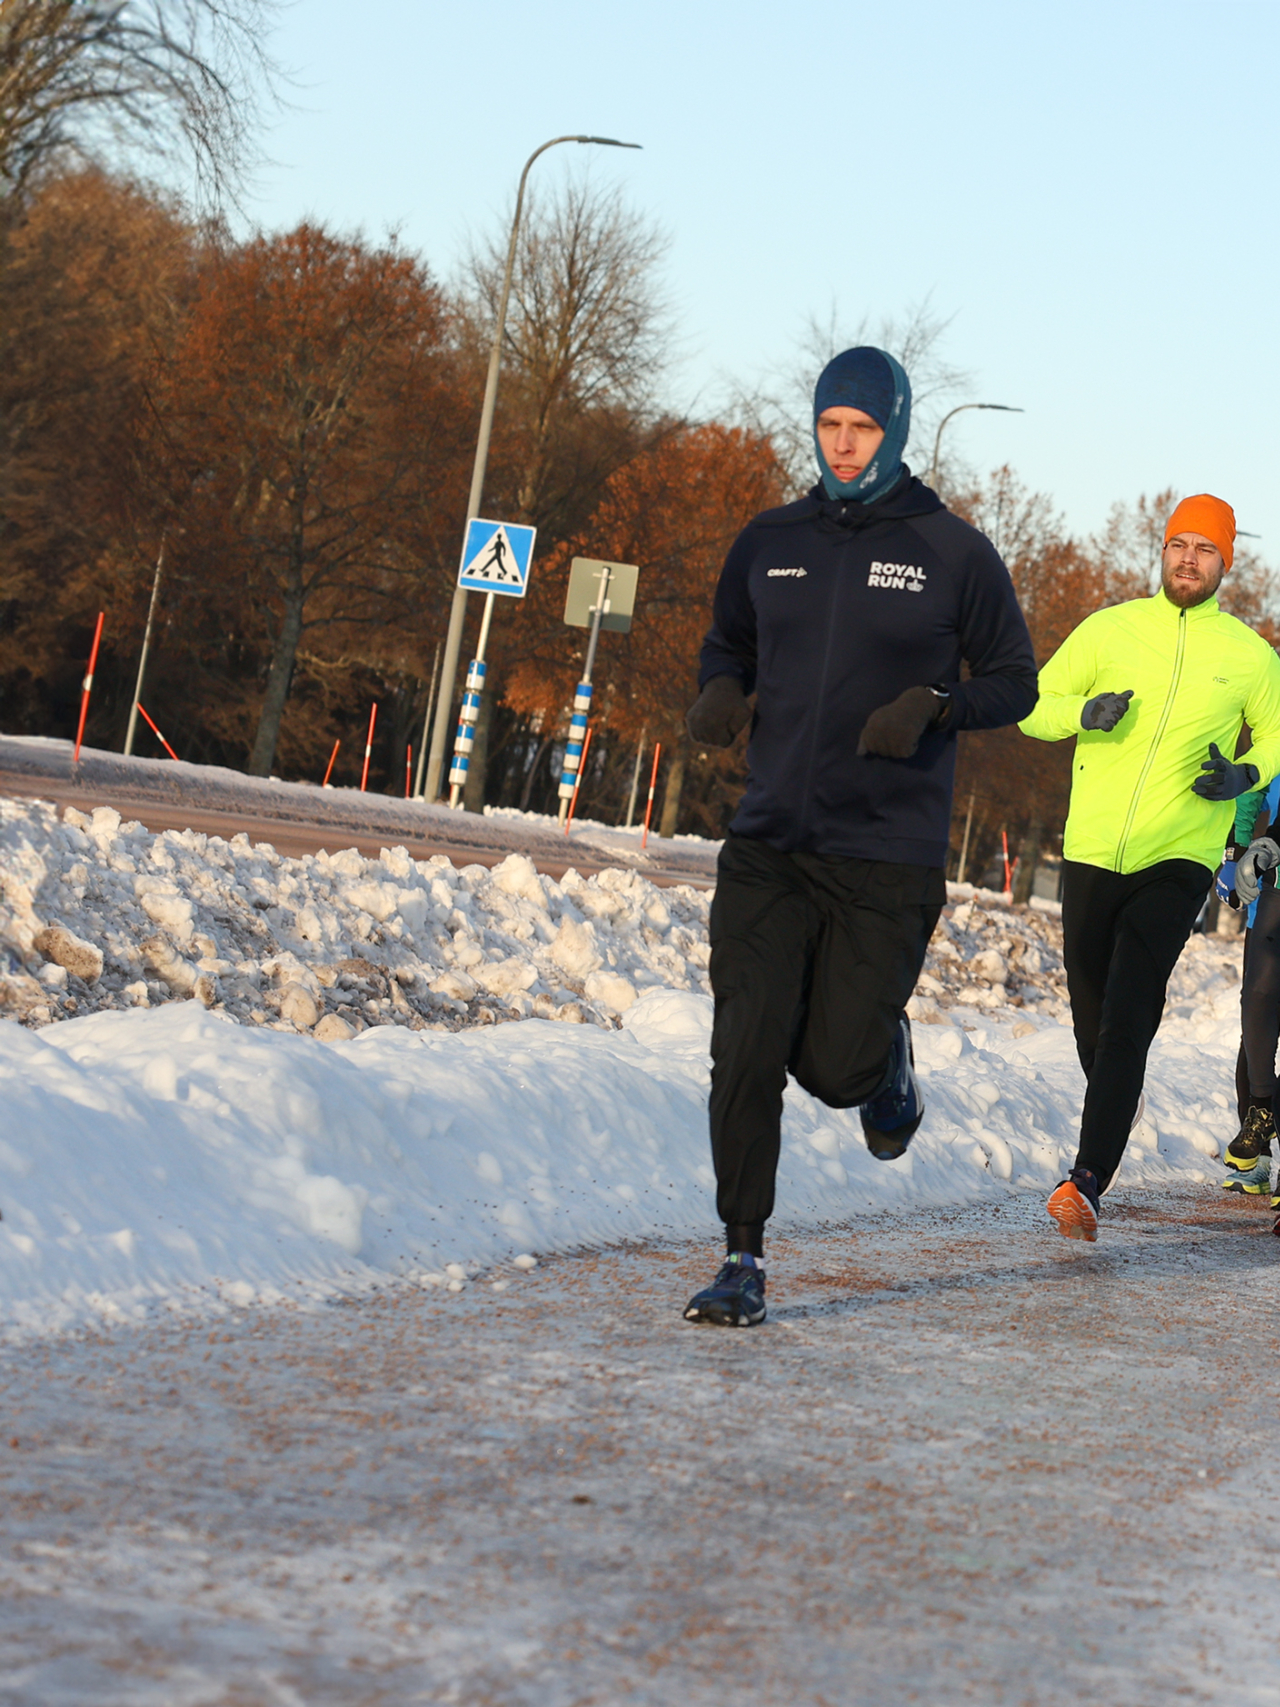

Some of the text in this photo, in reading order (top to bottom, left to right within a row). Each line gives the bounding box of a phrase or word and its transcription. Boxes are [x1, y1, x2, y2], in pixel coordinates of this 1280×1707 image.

[766, 568, 799, 578] CRAFT
[870, 561, 927, 580] ROYAL
[867, 574, 906, 590] RUN
